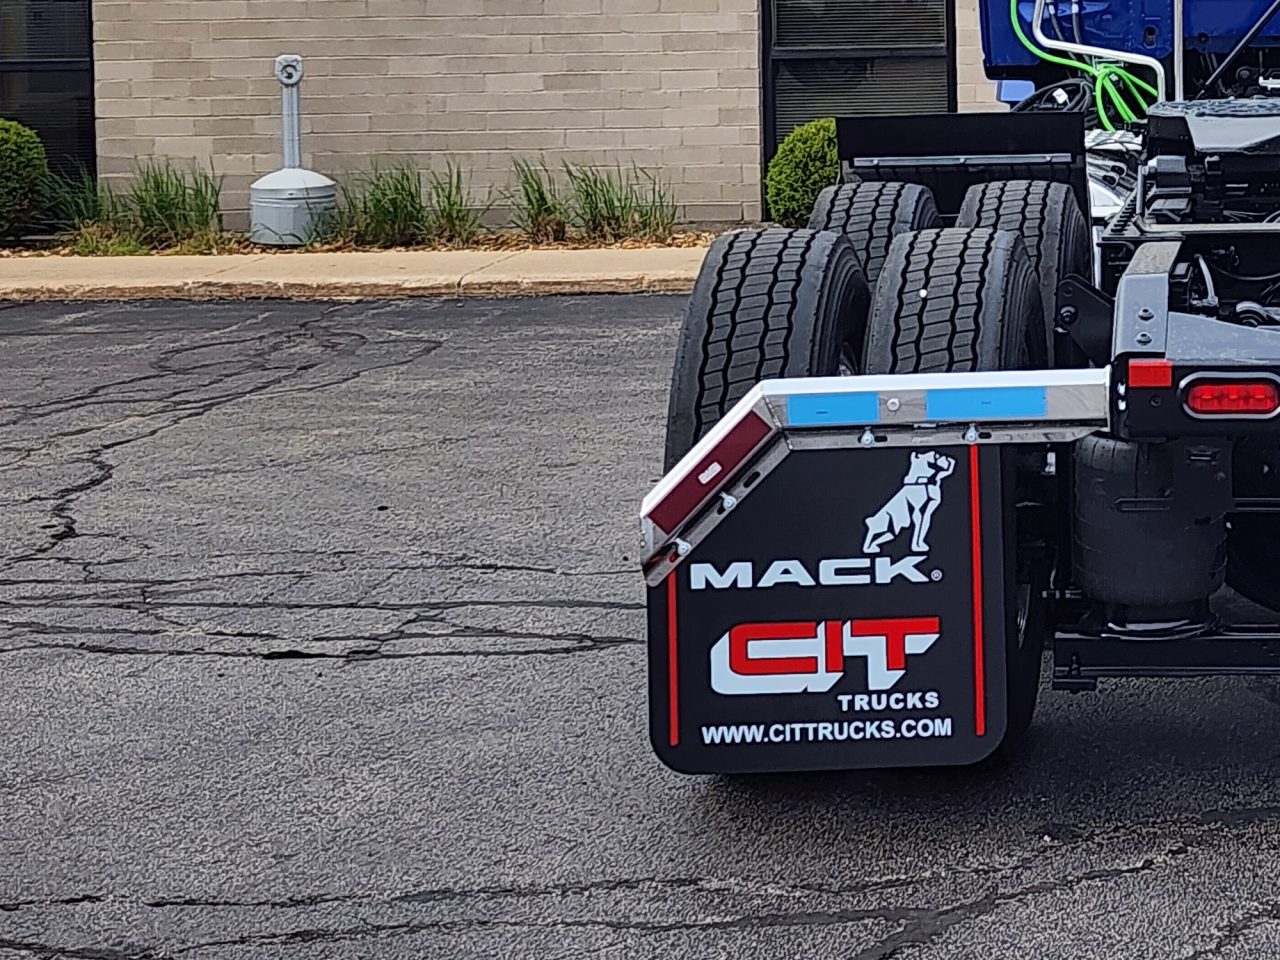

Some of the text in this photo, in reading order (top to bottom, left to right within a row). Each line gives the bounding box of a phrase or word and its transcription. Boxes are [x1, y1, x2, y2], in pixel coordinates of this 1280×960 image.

[689, 555, 931, 590] MACK
[727, 616, 941, 678] CIT
[837, 691, 940, 712] TRUCKS
[701, 717, 952, 745] WWW.CITTRUCKS.COM
